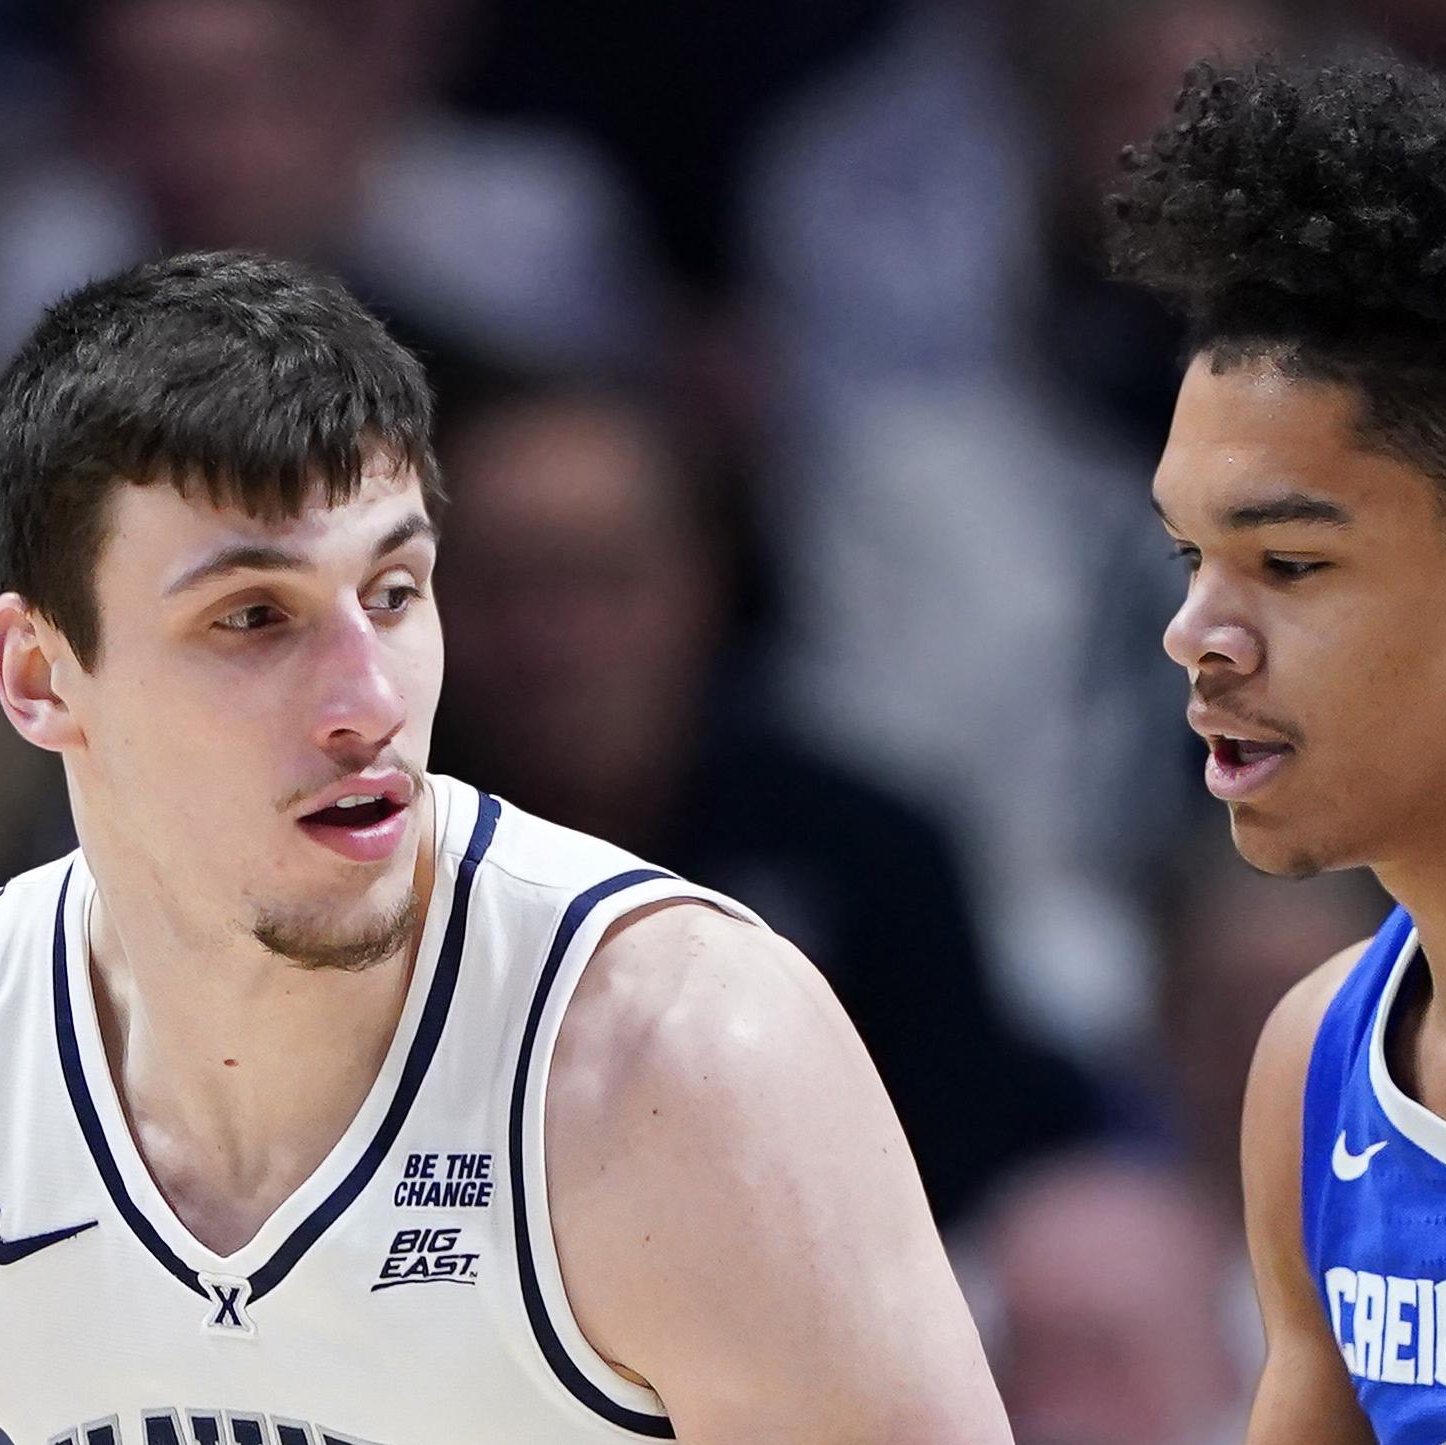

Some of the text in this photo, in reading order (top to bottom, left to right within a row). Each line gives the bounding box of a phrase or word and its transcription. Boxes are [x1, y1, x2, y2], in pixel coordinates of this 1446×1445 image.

[403, 1154, 492, 1180] BE THE
[393, 1181, 494, 1208] CHANGE
[389, 1228, 462, 1255] BIG
[379, 1254, 481, 1279] EAST
[208, 1281, 246, 1330] X
